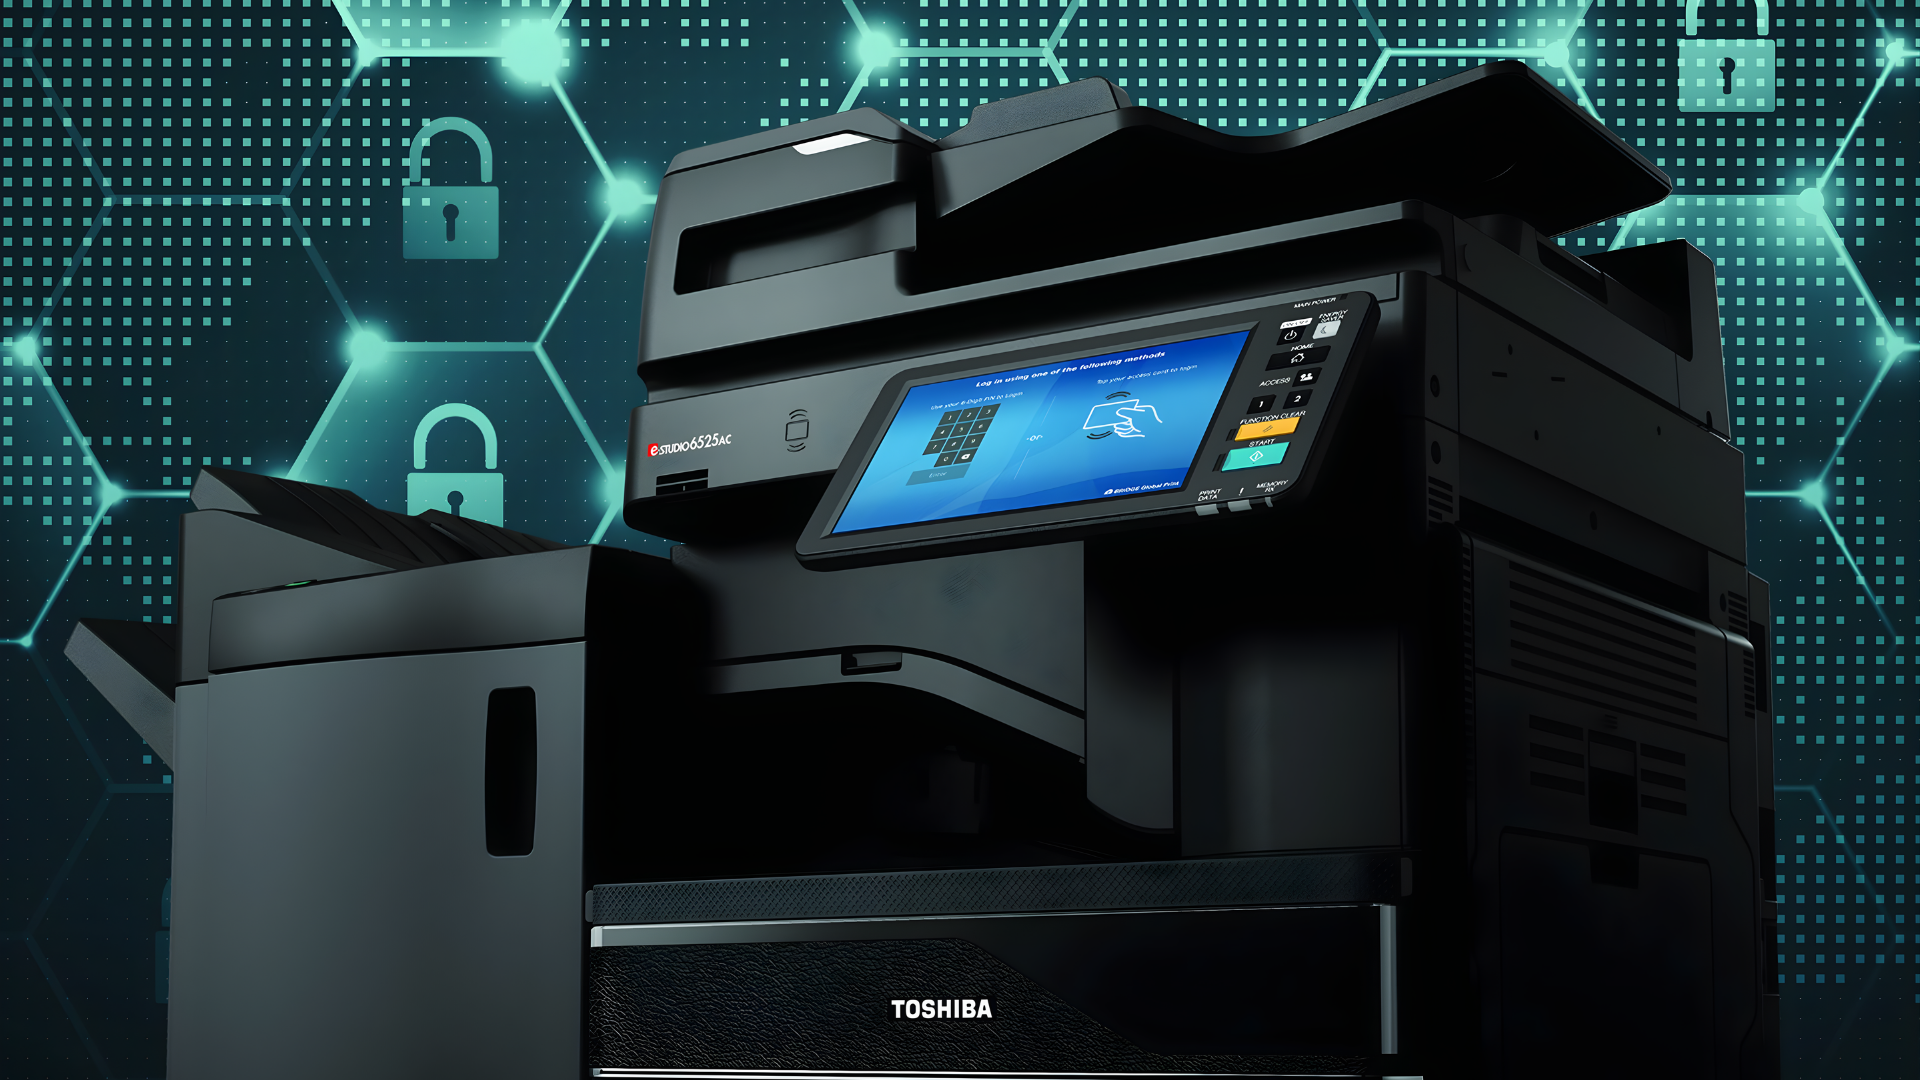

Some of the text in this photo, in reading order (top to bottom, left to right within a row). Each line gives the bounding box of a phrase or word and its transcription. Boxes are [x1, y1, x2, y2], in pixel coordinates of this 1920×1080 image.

[1290, 343, 1315, 352] HOME
[1005, 374, 1029, 383] using
[1062, 365, 1077, 373] the
[1080, 358, 1122, 370] following
[1124, 351, 1166, 363] methods
[1259, 377, 1291, 387] ACCESS
[1259, 395, 1301, 408] 1 2
[1240, 410, 1306, 425] FUNCTION CLEAR
[1248, 438, 1276, 448] START
[1256, 479, 1289, 489] MEMORY
[1199, 488, 1222, 496] PRINT
[891, 999, 993, 1019] TOSHIBA
